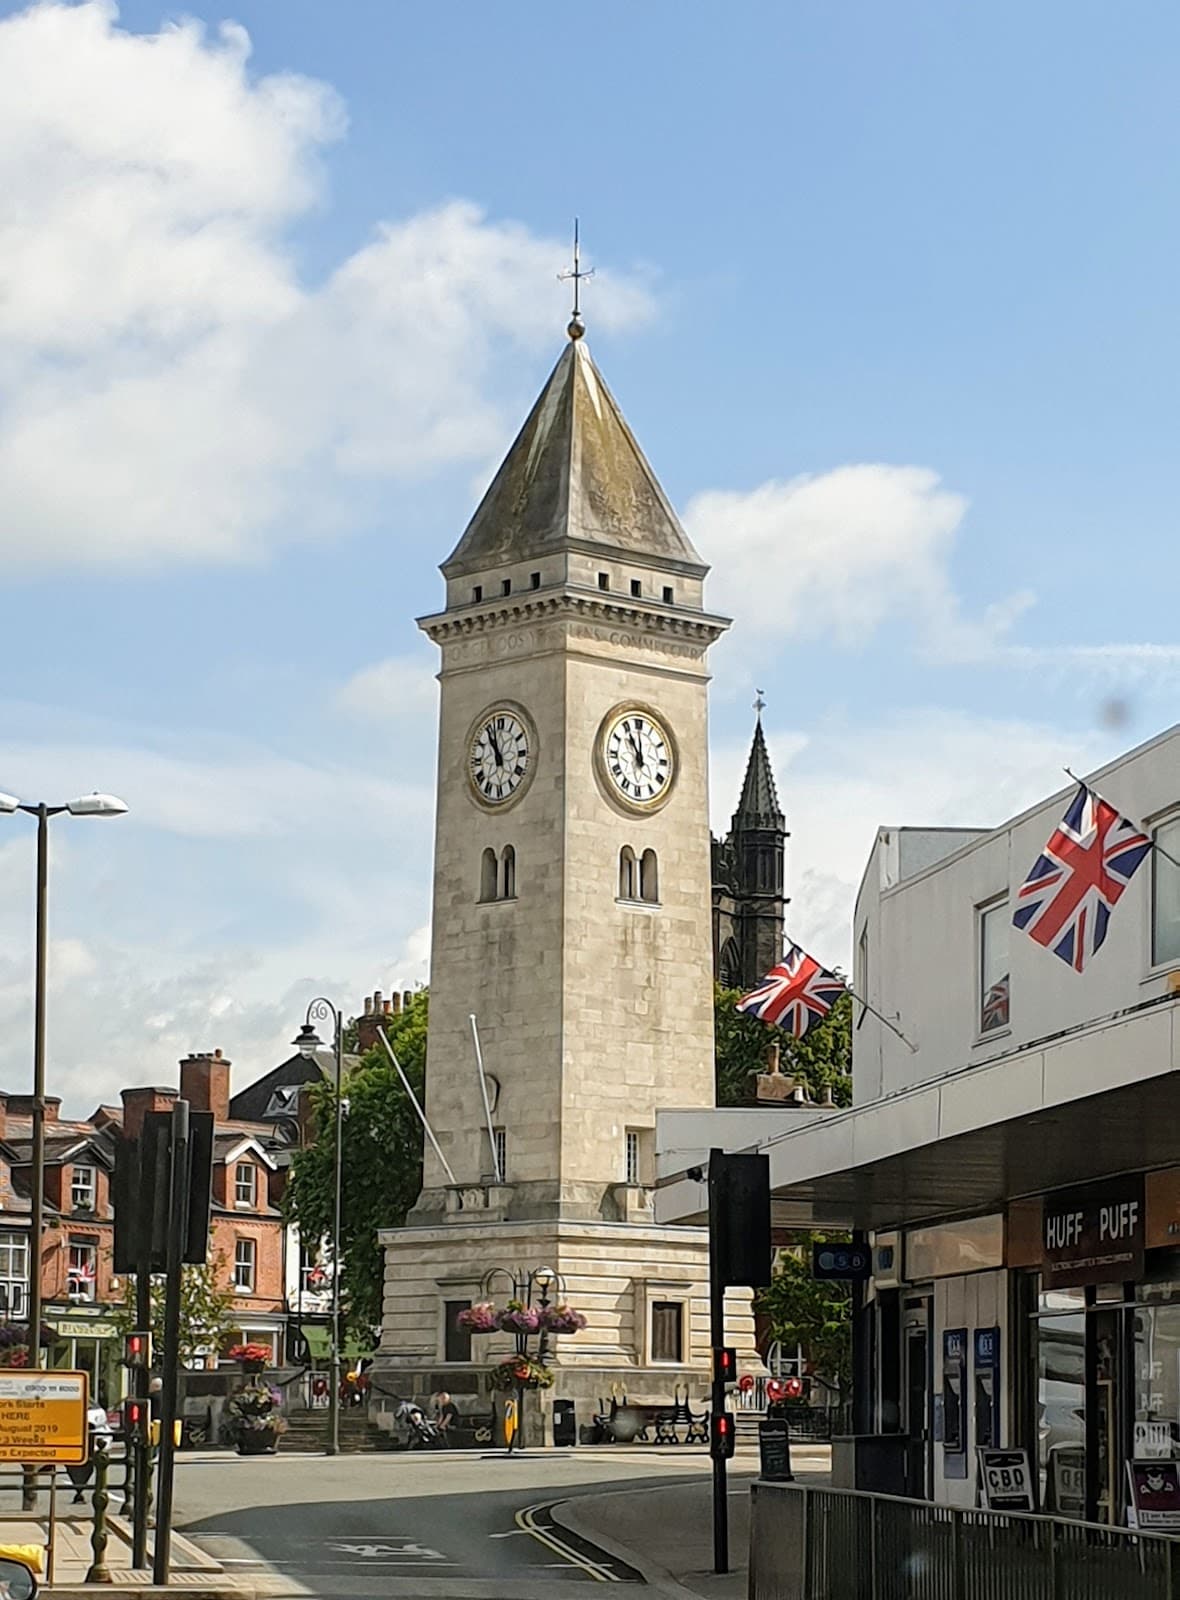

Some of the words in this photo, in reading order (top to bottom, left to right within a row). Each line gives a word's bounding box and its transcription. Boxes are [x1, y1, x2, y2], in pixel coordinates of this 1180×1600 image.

[1046, 1212, 1083, 1249] HUFF
[1099, 1201, 1139, 1241] PUFF
[0, 1400, 14, 1408] ork
[16, 1399, 45, 1408] Starts
[1, 1411, 30, 1420] HERE
[0, 1424, 32, 1434] August
[34, 1424, 58, 1433] 2019
[13, 1435, 46, 1444] Weeks
[10, 1448, 57, 1458] Expected
